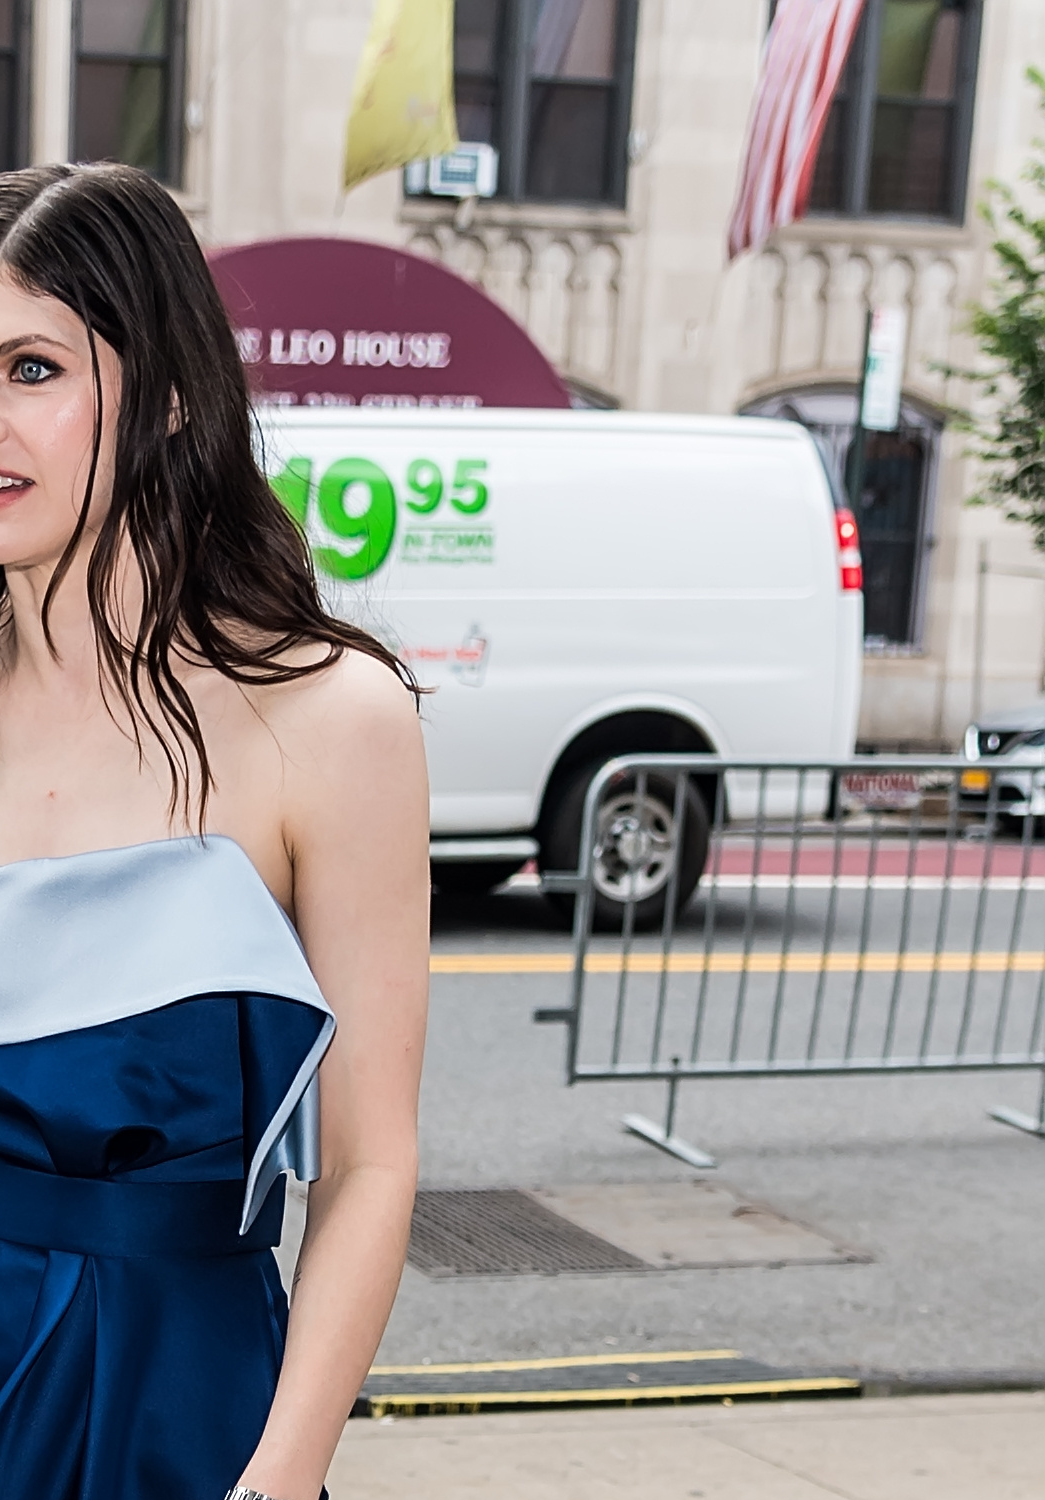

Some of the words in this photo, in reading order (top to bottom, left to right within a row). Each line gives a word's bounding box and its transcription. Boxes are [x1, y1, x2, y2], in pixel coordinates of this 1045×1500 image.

[270, 328, 337, 366] LEO
[342, 330, 451, 368] HOUSE
[405, 459, 488, 515] 95
